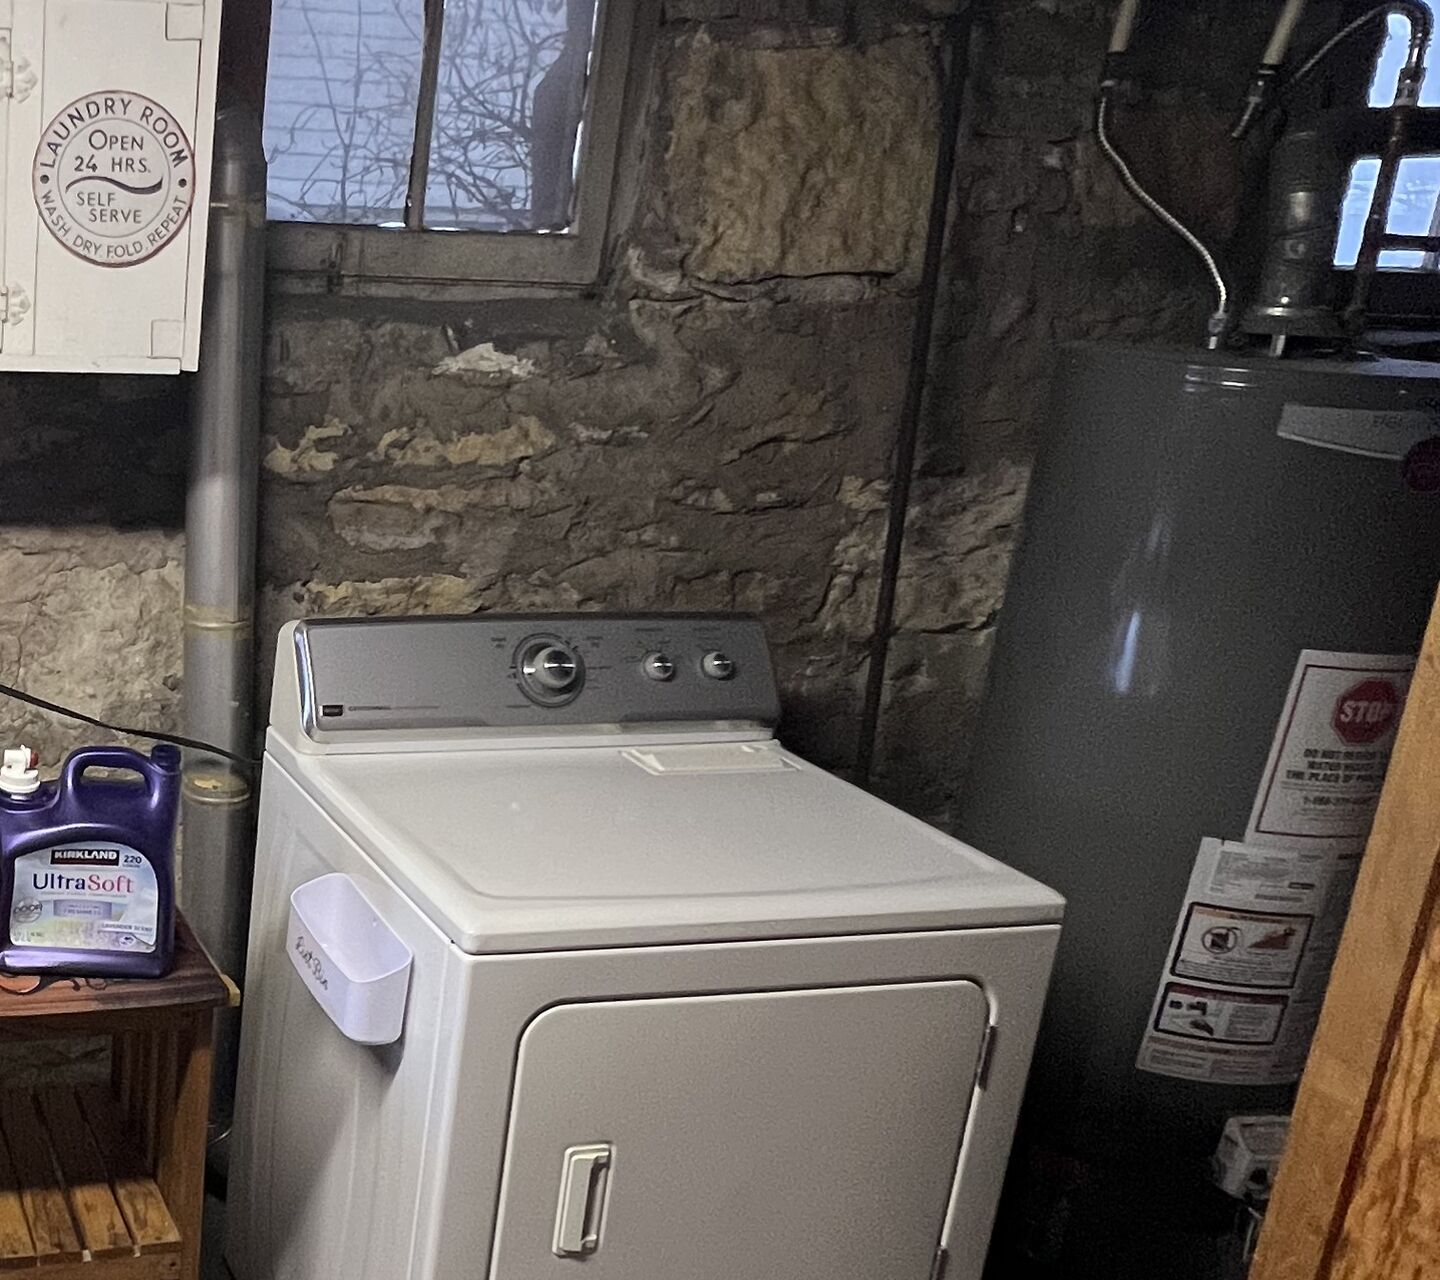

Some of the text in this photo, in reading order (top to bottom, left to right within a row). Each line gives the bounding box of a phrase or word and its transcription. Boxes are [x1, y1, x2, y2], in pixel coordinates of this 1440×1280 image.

[40, 97, 188, 168] LAUNDRY ROOM
[74, 154, 151, 173] 24 HRS.
[76, 192, 116, 207] SELF
[89, 209, 142, 224] SERVE
[149, 195, 188, 247] REPEAT
[54, 850, 143, 864] KIRKLAND 220
[32, 872, 134, 894] UltraSoft
